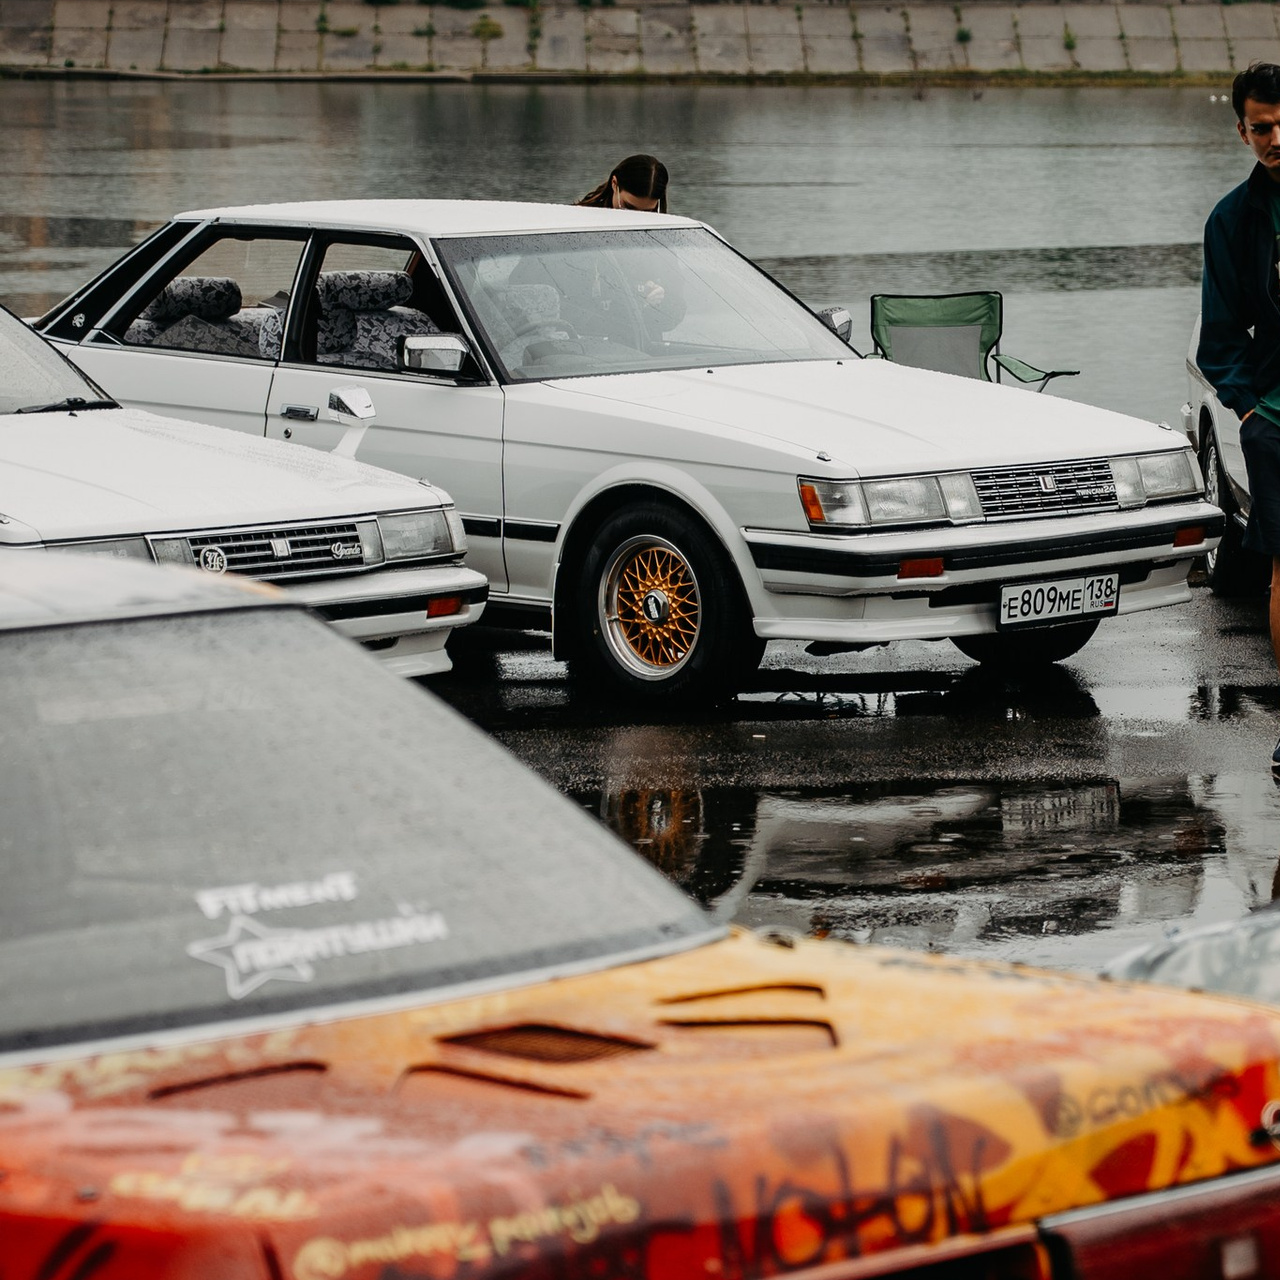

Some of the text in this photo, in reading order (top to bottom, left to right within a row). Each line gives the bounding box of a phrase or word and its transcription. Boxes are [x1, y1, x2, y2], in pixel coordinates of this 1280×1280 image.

[1103, 484, 1116, 494] 24
[1007, 577, 1114, 619] Е809МЕ 138
[1090, 599, 1104, 608] RUS
